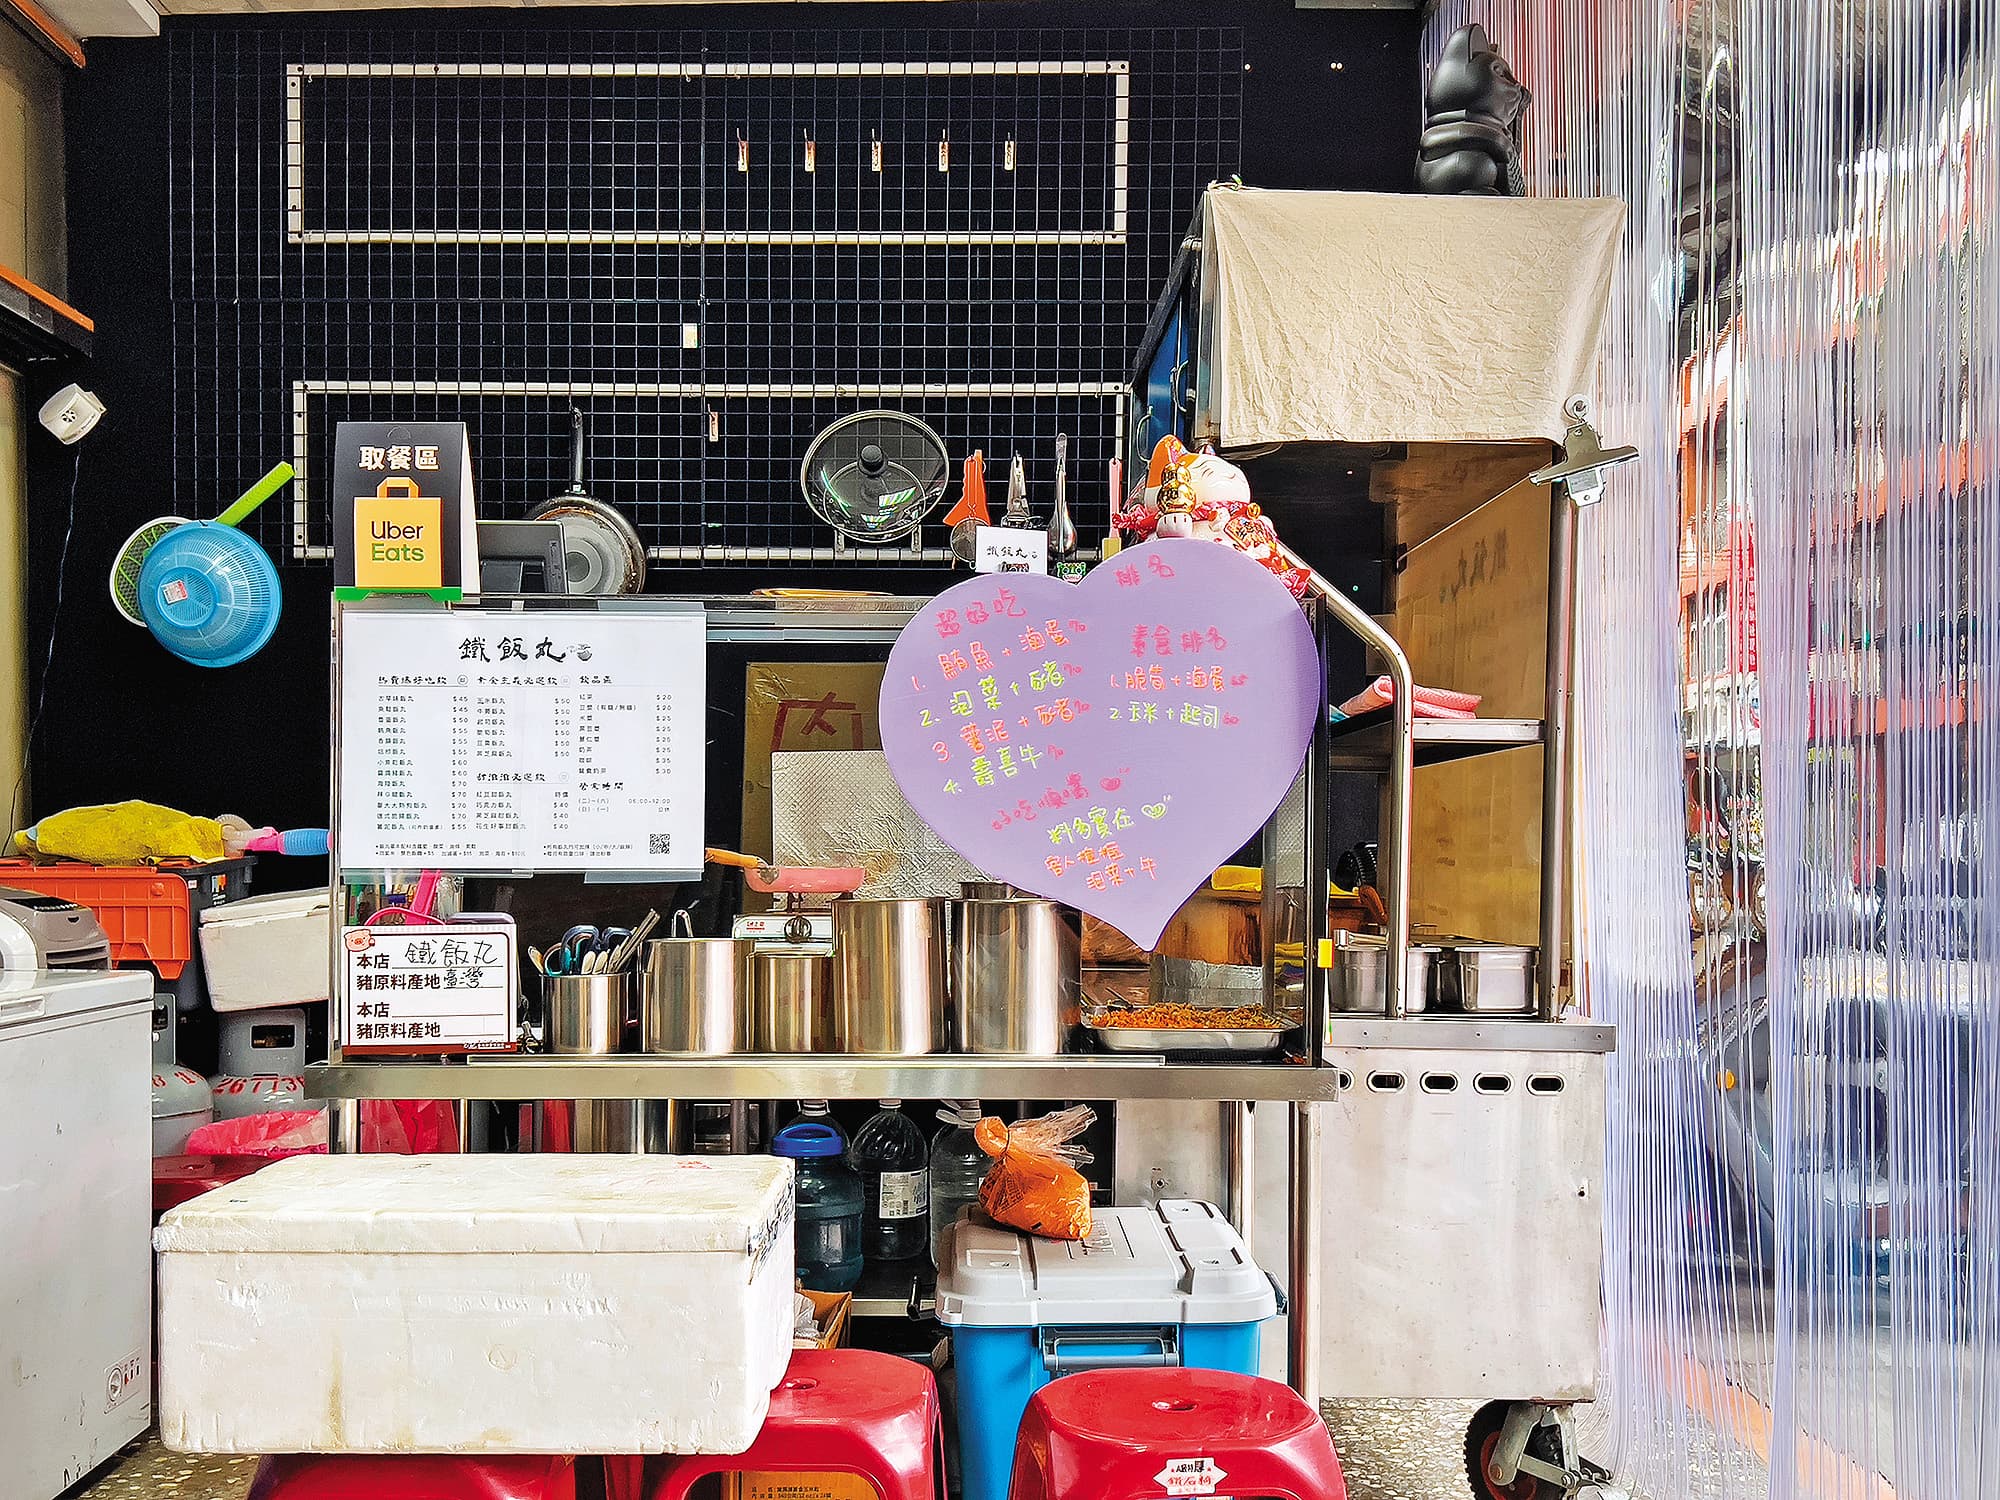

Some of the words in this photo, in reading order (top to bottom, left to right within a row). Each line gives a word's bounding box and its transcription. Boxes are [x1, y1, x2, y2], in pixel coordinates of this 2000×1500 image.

[359, 445, 440, 471] 取餐區
[371, 520, 424, 540] Uber
[372, 542, 425, 562] Eats
[935, 587, 1027, 639] 超好吃
[1113, 554, 1175, 588] 排名
[459, 636, 566, 663] 鐵飯丸
[1130, 623, 1227, 658] 素食排名
[1047, 805, 1135, 844] 料多實在
[357, 953, 390, 969] 本店
[405, 938, 498, 967] 鐵飯丸
[356, 974, 440, 990] 豬原料產地
[443, 967, 483, 988] 臺灣
[357, 1002, 390, 1018] 本店
[356, 1022, 440, 1039] 豬原料產地
